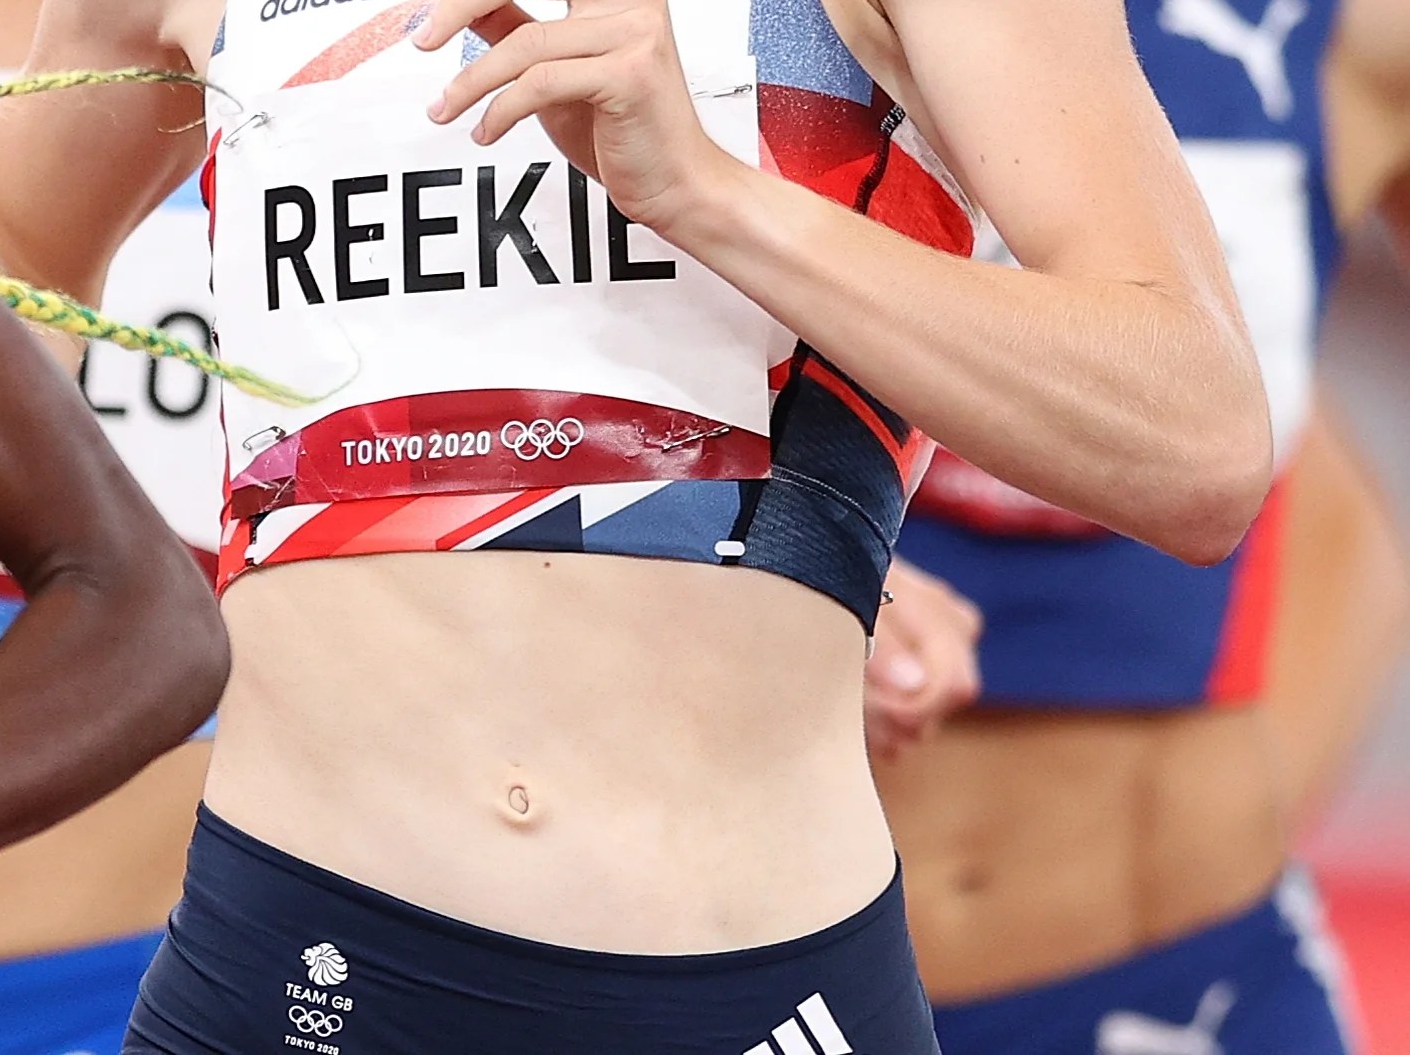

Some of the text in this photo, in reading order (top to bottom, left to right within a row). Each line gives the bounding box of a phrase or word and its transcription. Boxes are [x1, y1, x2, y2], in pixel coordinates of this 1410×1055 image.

[341, 430, 492, 467] TOKYO 2020
[285, 982, 353, 1012] TEAM GB
[284, 1035, 340, 1055] TOKYO 2020
